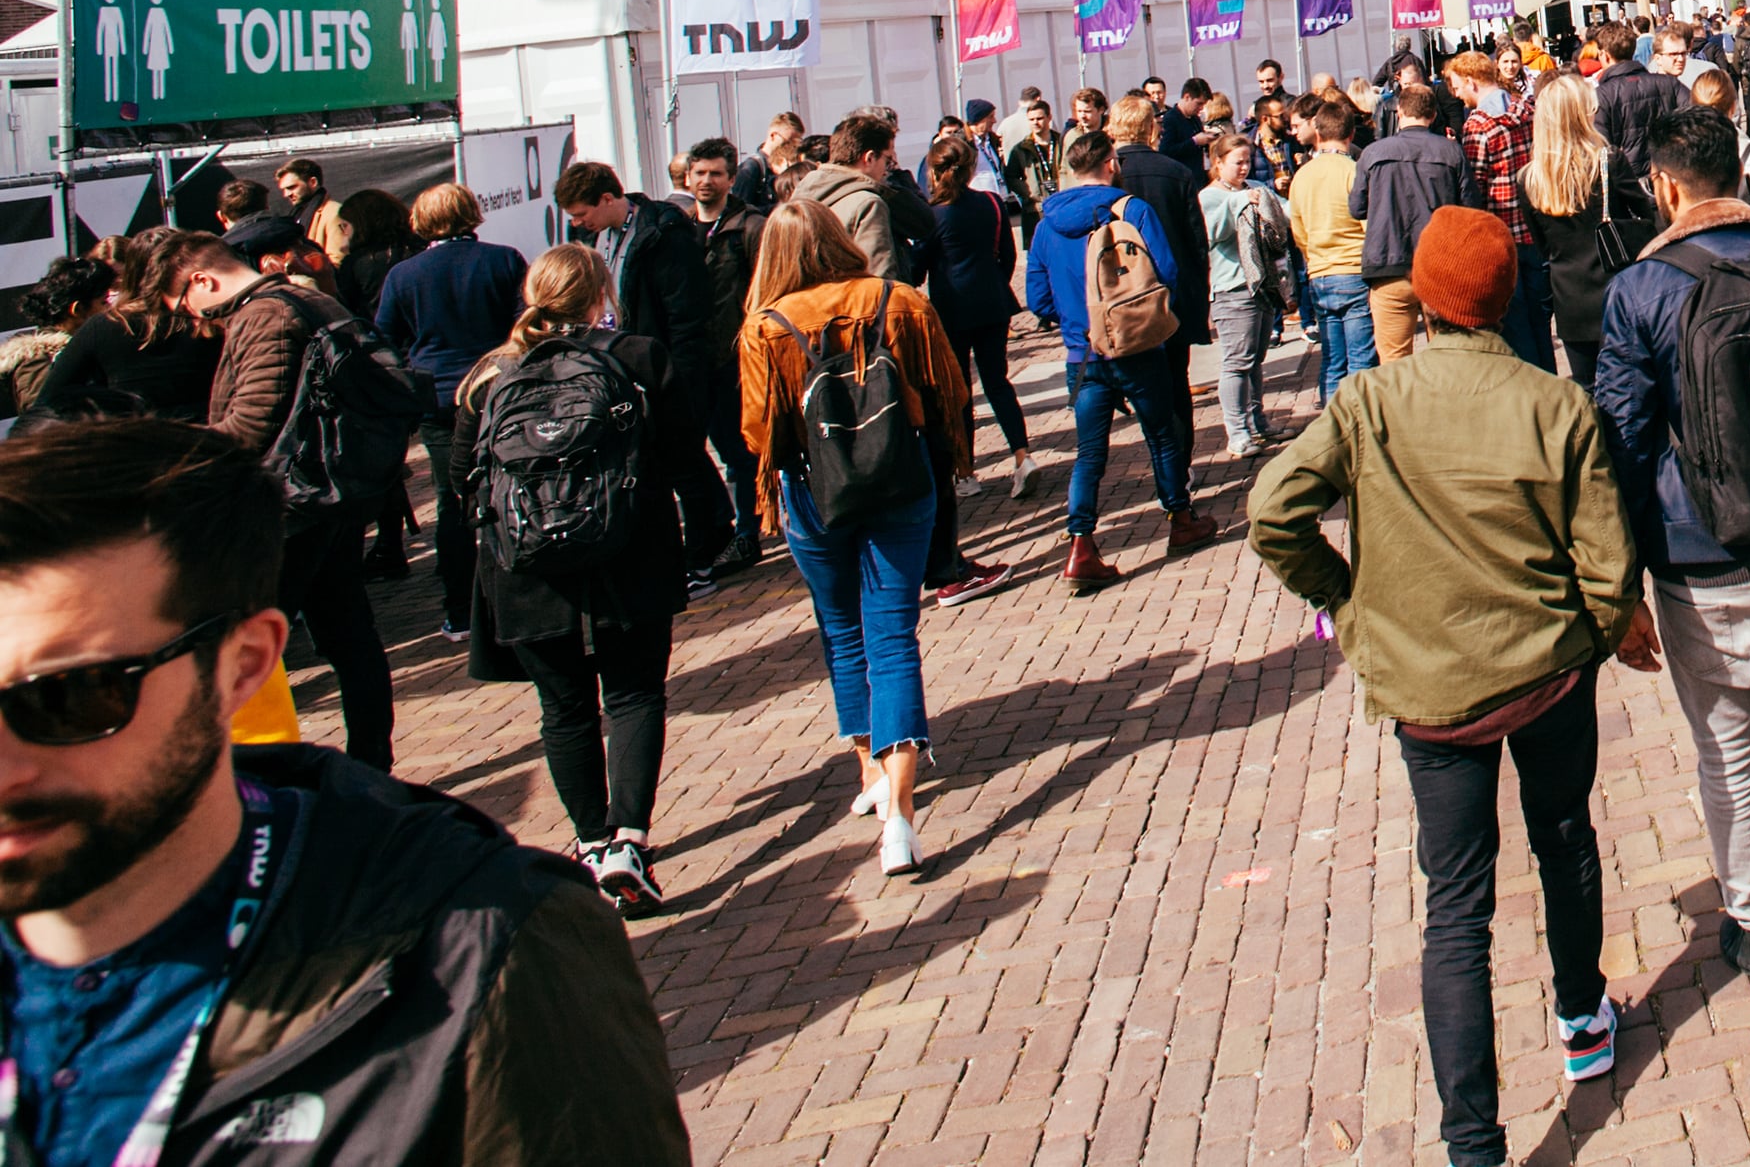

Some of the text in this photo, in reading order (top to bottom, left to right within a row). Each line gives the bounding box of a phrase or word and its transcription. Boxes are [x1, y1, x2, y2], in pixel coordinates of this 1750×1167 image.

[216, 7, 373, 75] TOILETS
[683, 19, 810, 56] TNW
[477, 193, 489, 213] The
[488, 188, 505, 211] heart
[510, 185, 523, 205] tech
